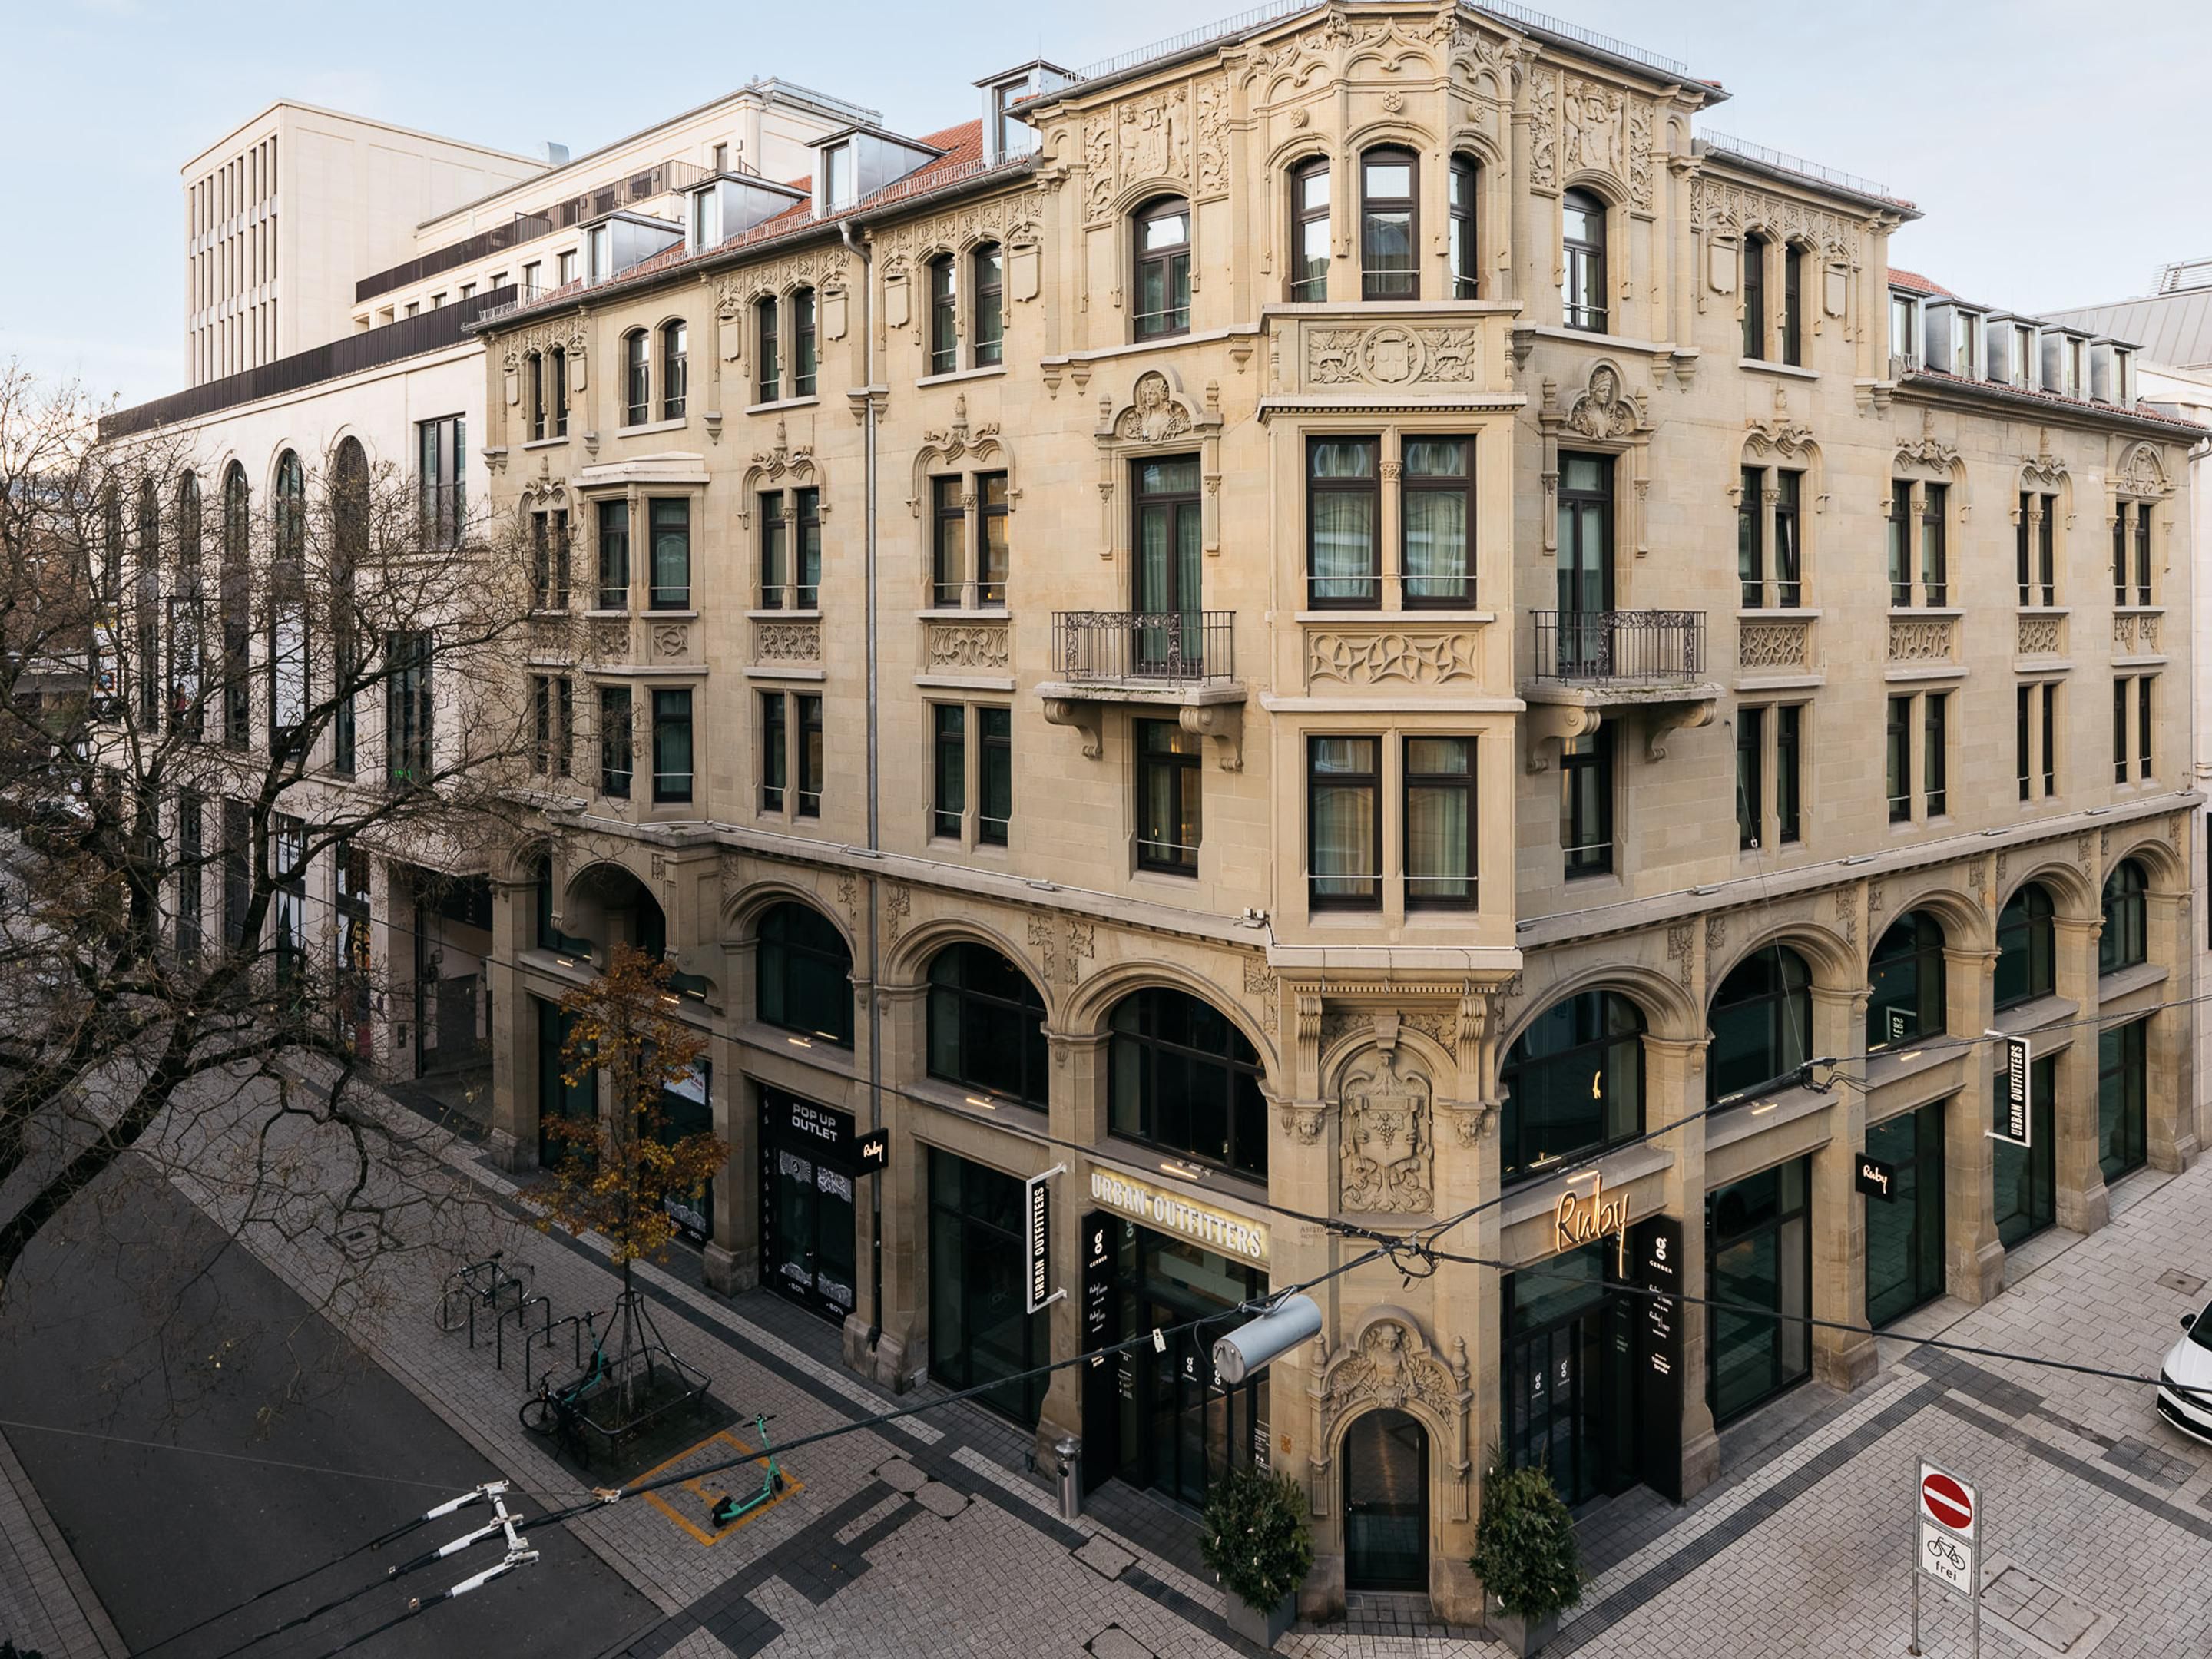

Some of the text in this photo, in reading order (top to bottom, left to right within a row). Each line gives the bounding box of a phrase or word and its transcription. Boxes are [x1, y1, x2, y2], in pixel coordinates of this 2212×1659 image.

[2011, 1045, 2023, 1136] URBAN OUTFITTERS
[792, 1116, 837, 1142] OUTLET
[793, 1103, 836, 1127] POP UP
[863, 1141, 883, 1163] Ruby
[1863, 1164, 1888, 1194] Ruby
[1091, 1173, 1263, 1258] URBAN OUTFITTERS
[1556, 1174, 1630, 1279] Ruby
[1034, 1187, 1045, 1300] URBAN OUTFITTERS
[1649, 1260, 1673, 1275] GERBER
[1936, 1561, 1957, 1581] frei
